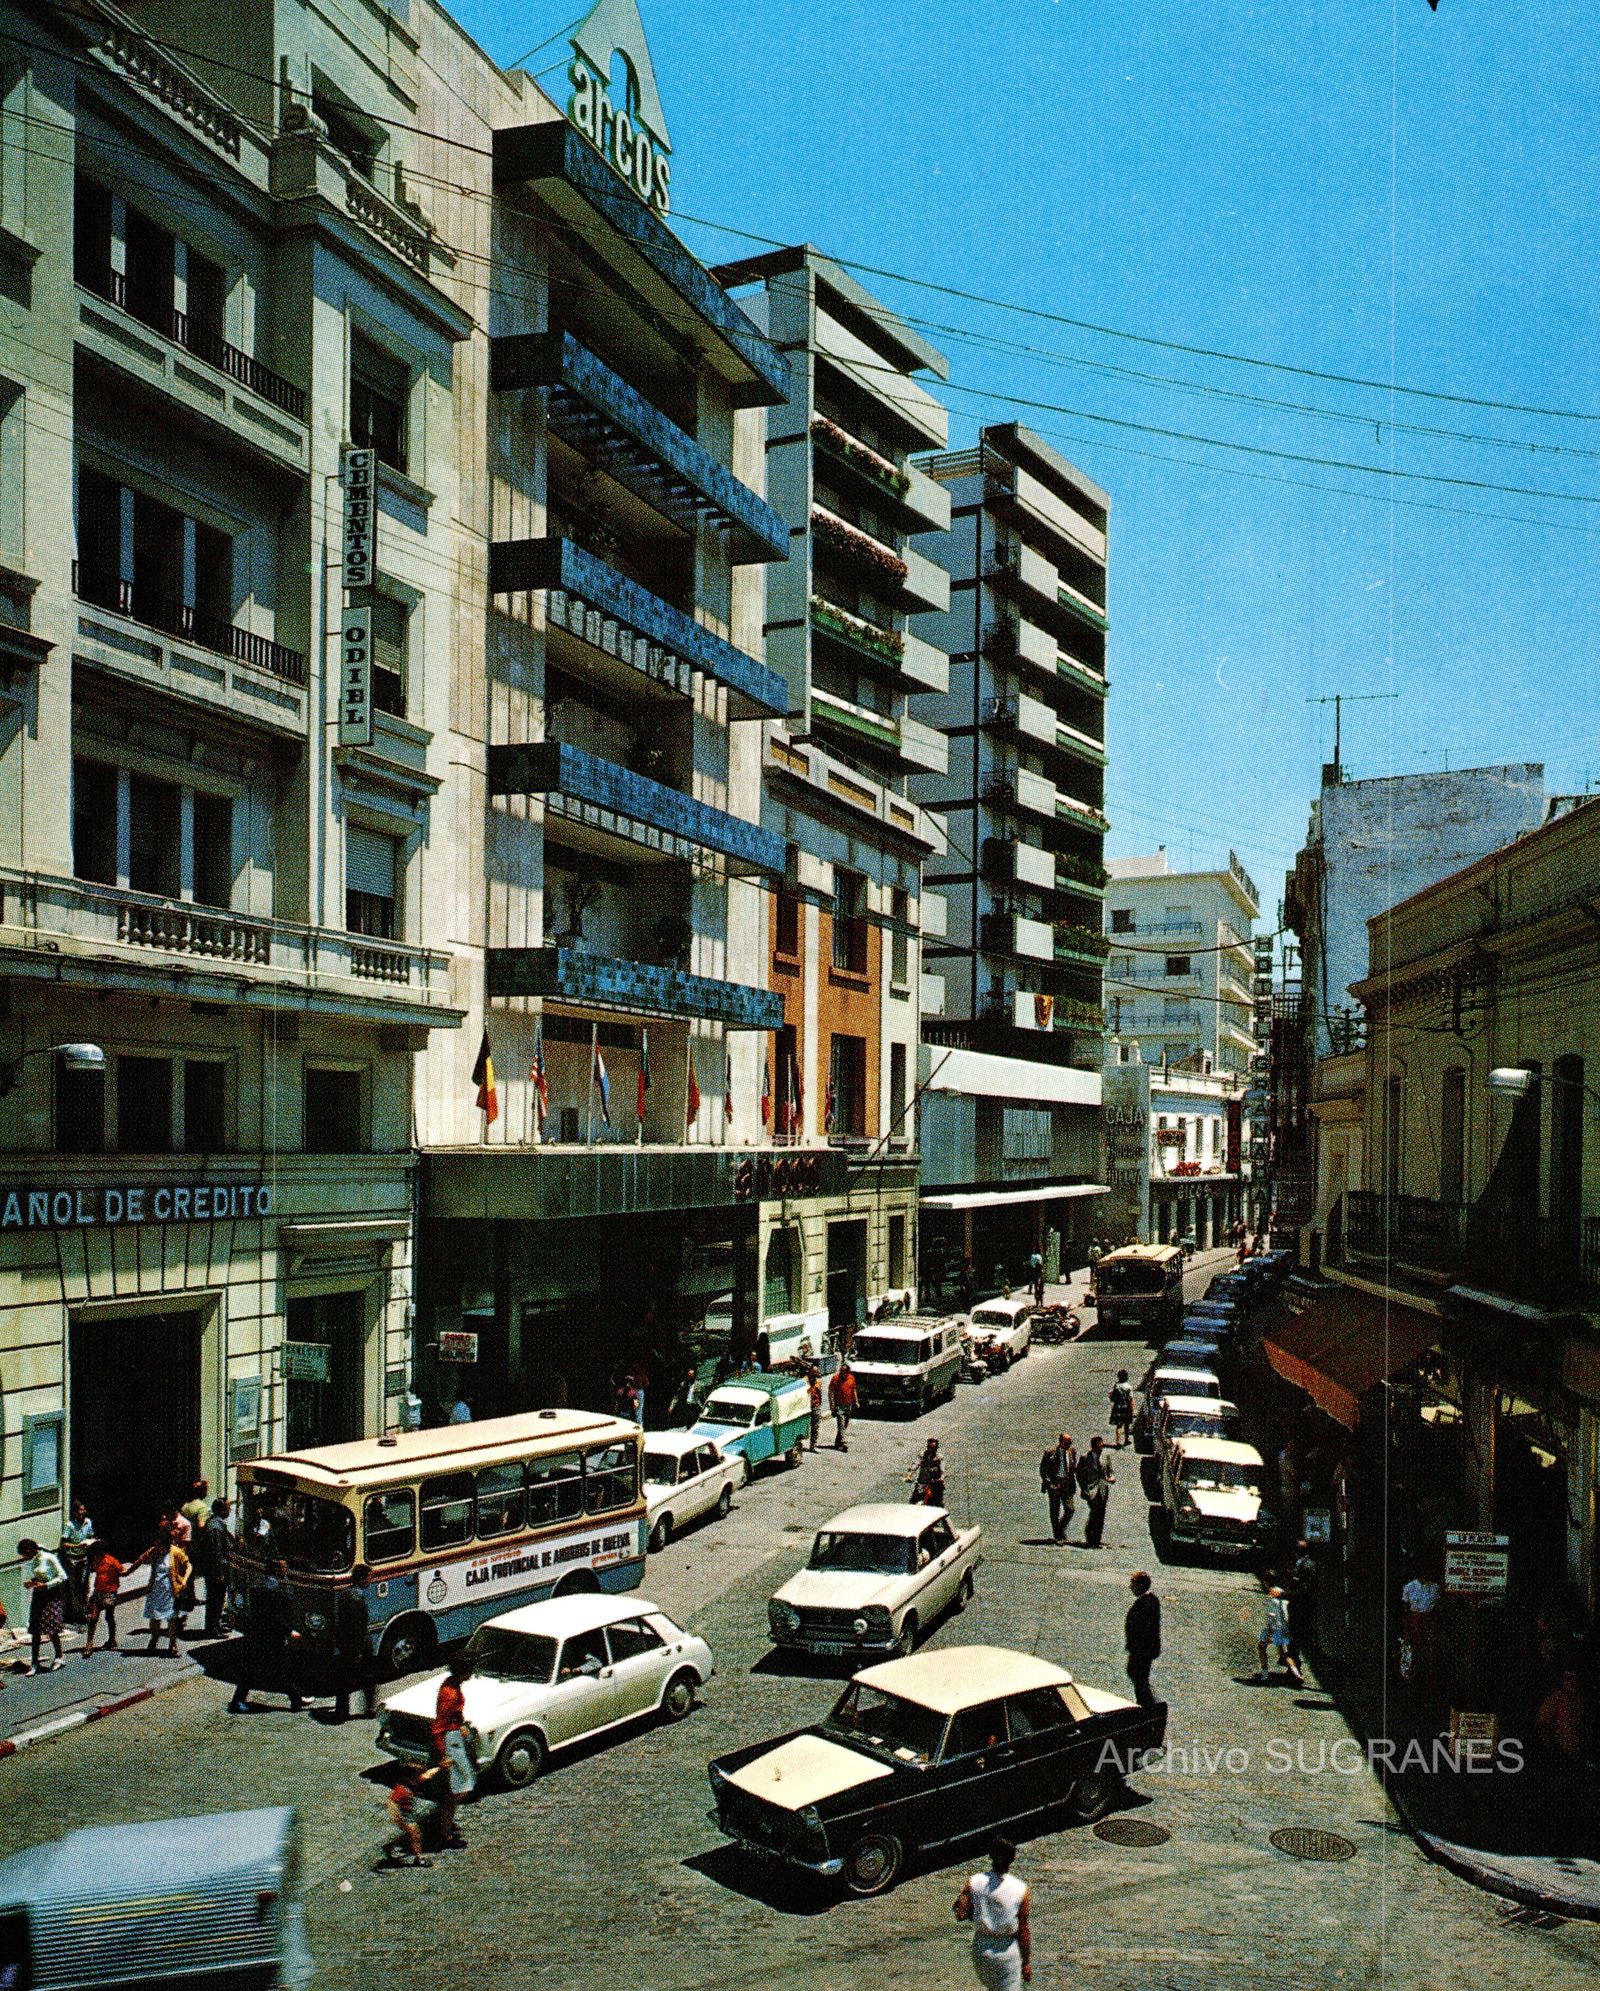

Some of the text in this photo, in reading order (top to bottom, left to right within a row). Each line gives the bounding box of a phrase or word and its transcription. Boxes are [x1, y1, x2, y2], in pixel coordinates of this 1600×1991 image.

[569, 61, 671, 217] arcos
[346, 453, 369, 583] CEMENTOS
[345, 627, 366, 724] ODIEL
[1253, 936, 1272, 1039] HOTEL
[1105, 1106, 1144, 1124] CAJA
[104, 1189, 144, 1222] DE
[154, 1186, 272, 1219] CREDITO
[466, 1565, 490, 1587] CAJA
[491, 1554, 540, 1581] PROVINCIAL
[541, 1551, 552, 1568] DE
[553, 1543, 590, 1564] AHORROS
[589, 1538, 601, 1554] DE
[602, 1532, 631, 1550] HUELVA
